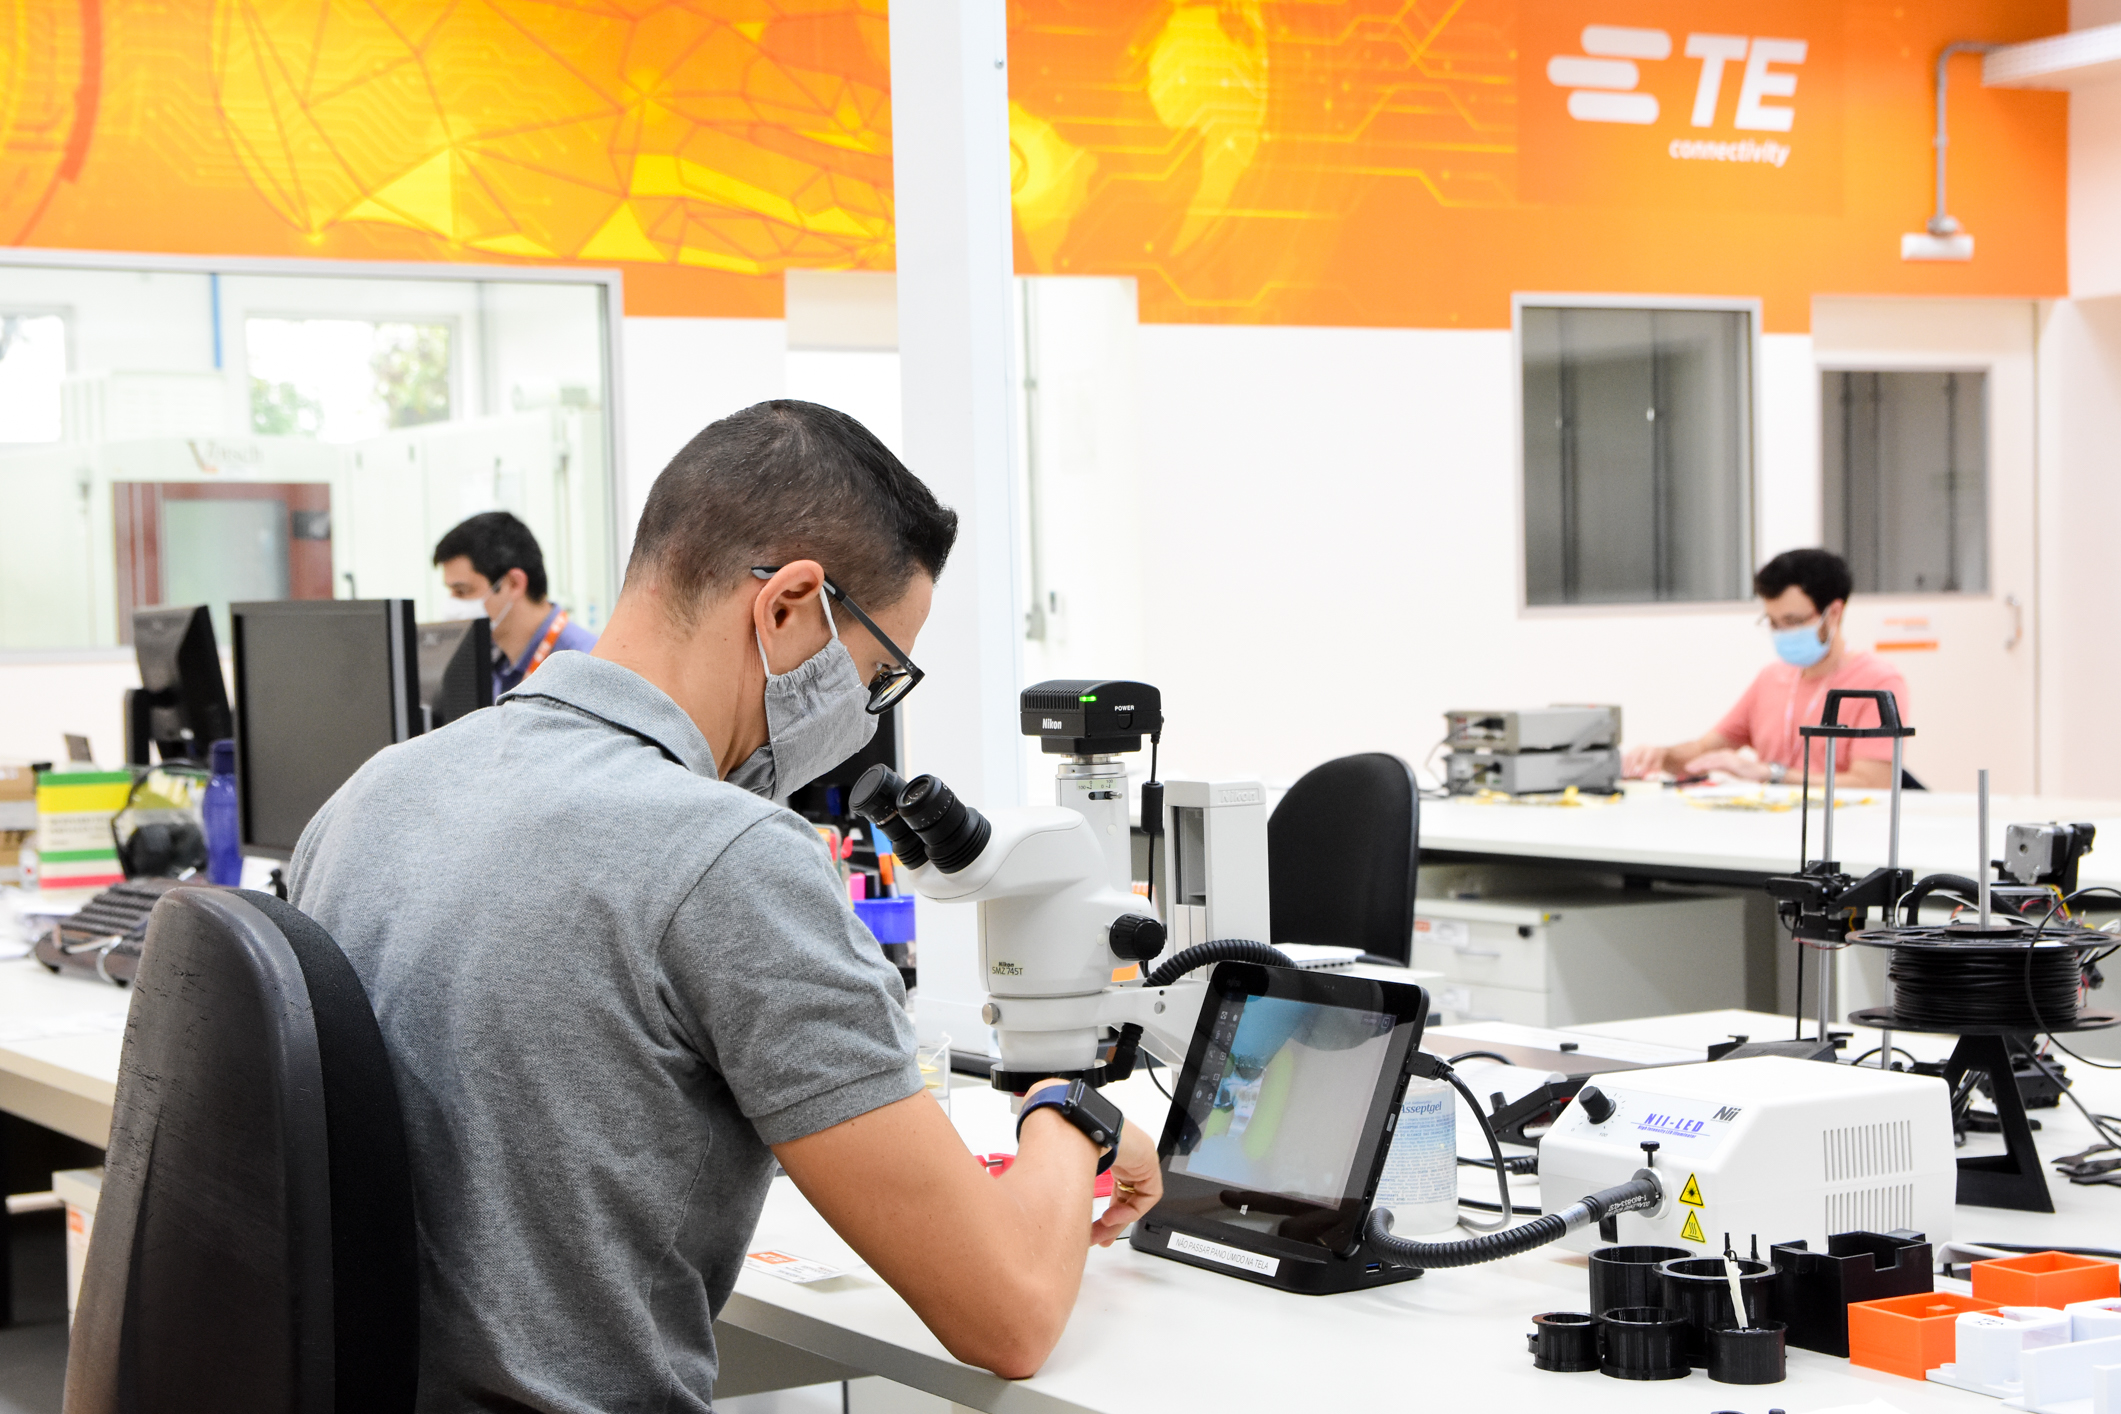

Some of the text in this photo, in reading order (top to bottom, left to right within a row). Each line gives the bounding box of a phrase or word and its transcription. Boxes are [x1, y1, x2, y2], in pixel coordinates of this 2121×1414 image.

[1684, 33, 1808, 132] TE
[1668, 138, 1791, 168] connectivity
[1042, 718, 1062, 729] Nikon
[1221, 790, 1256, 803] Nikon
[1644, 1113, 1704, 1132] NII-LED
[1712, 1106, 1742, 1122] Nii
[1175, 1238, 1269, 1270] NÃO PASSAR PANO ÚMIDO NA TELA
